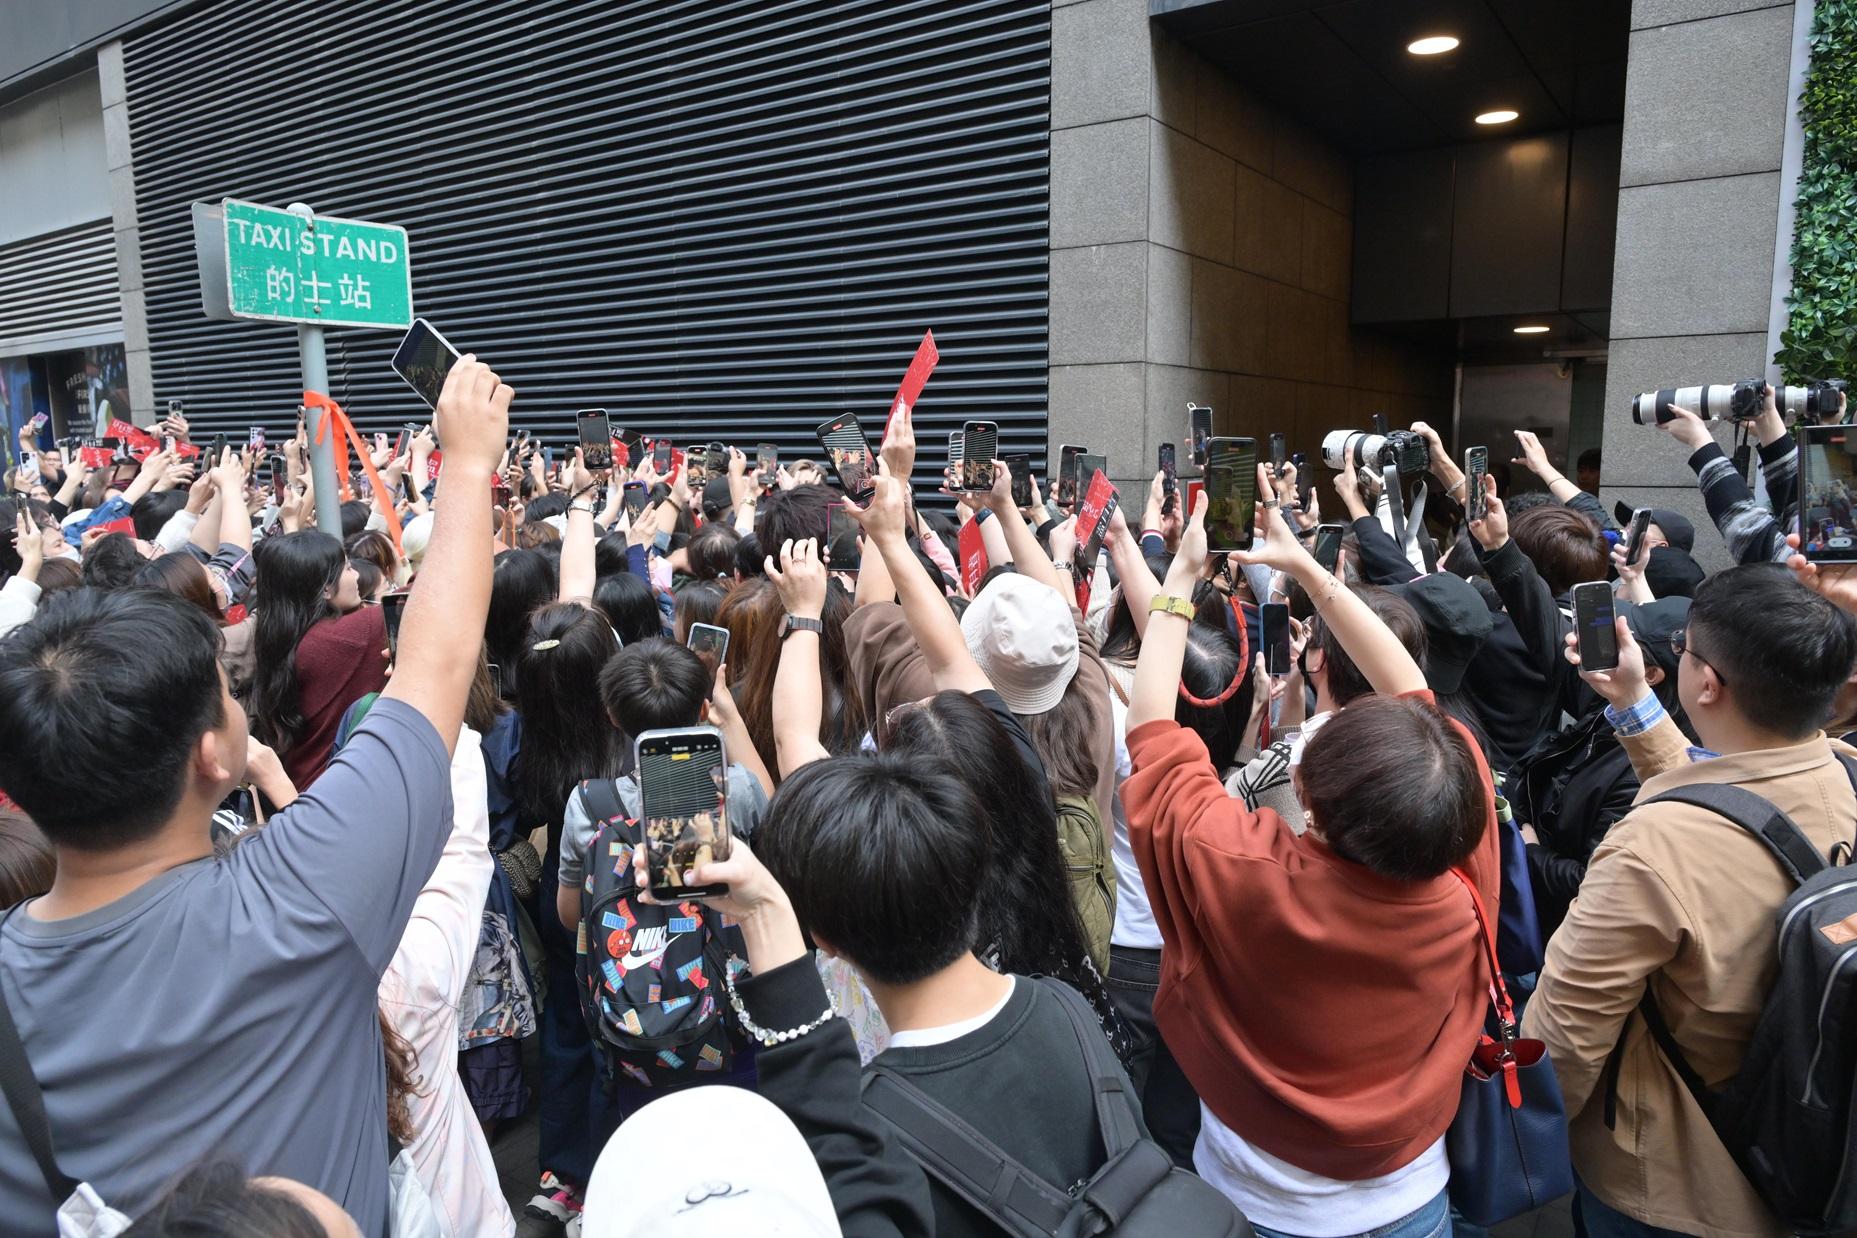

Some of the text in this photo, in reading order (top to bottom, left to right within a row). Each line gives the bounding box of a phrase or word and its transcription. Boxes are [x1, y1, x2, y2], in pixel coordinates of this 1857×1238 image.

[236, 219, 398, 264] TAXI STAND
[266, 264, 372, 310] 的士站
[671, 919, 695, 932] NIKE
